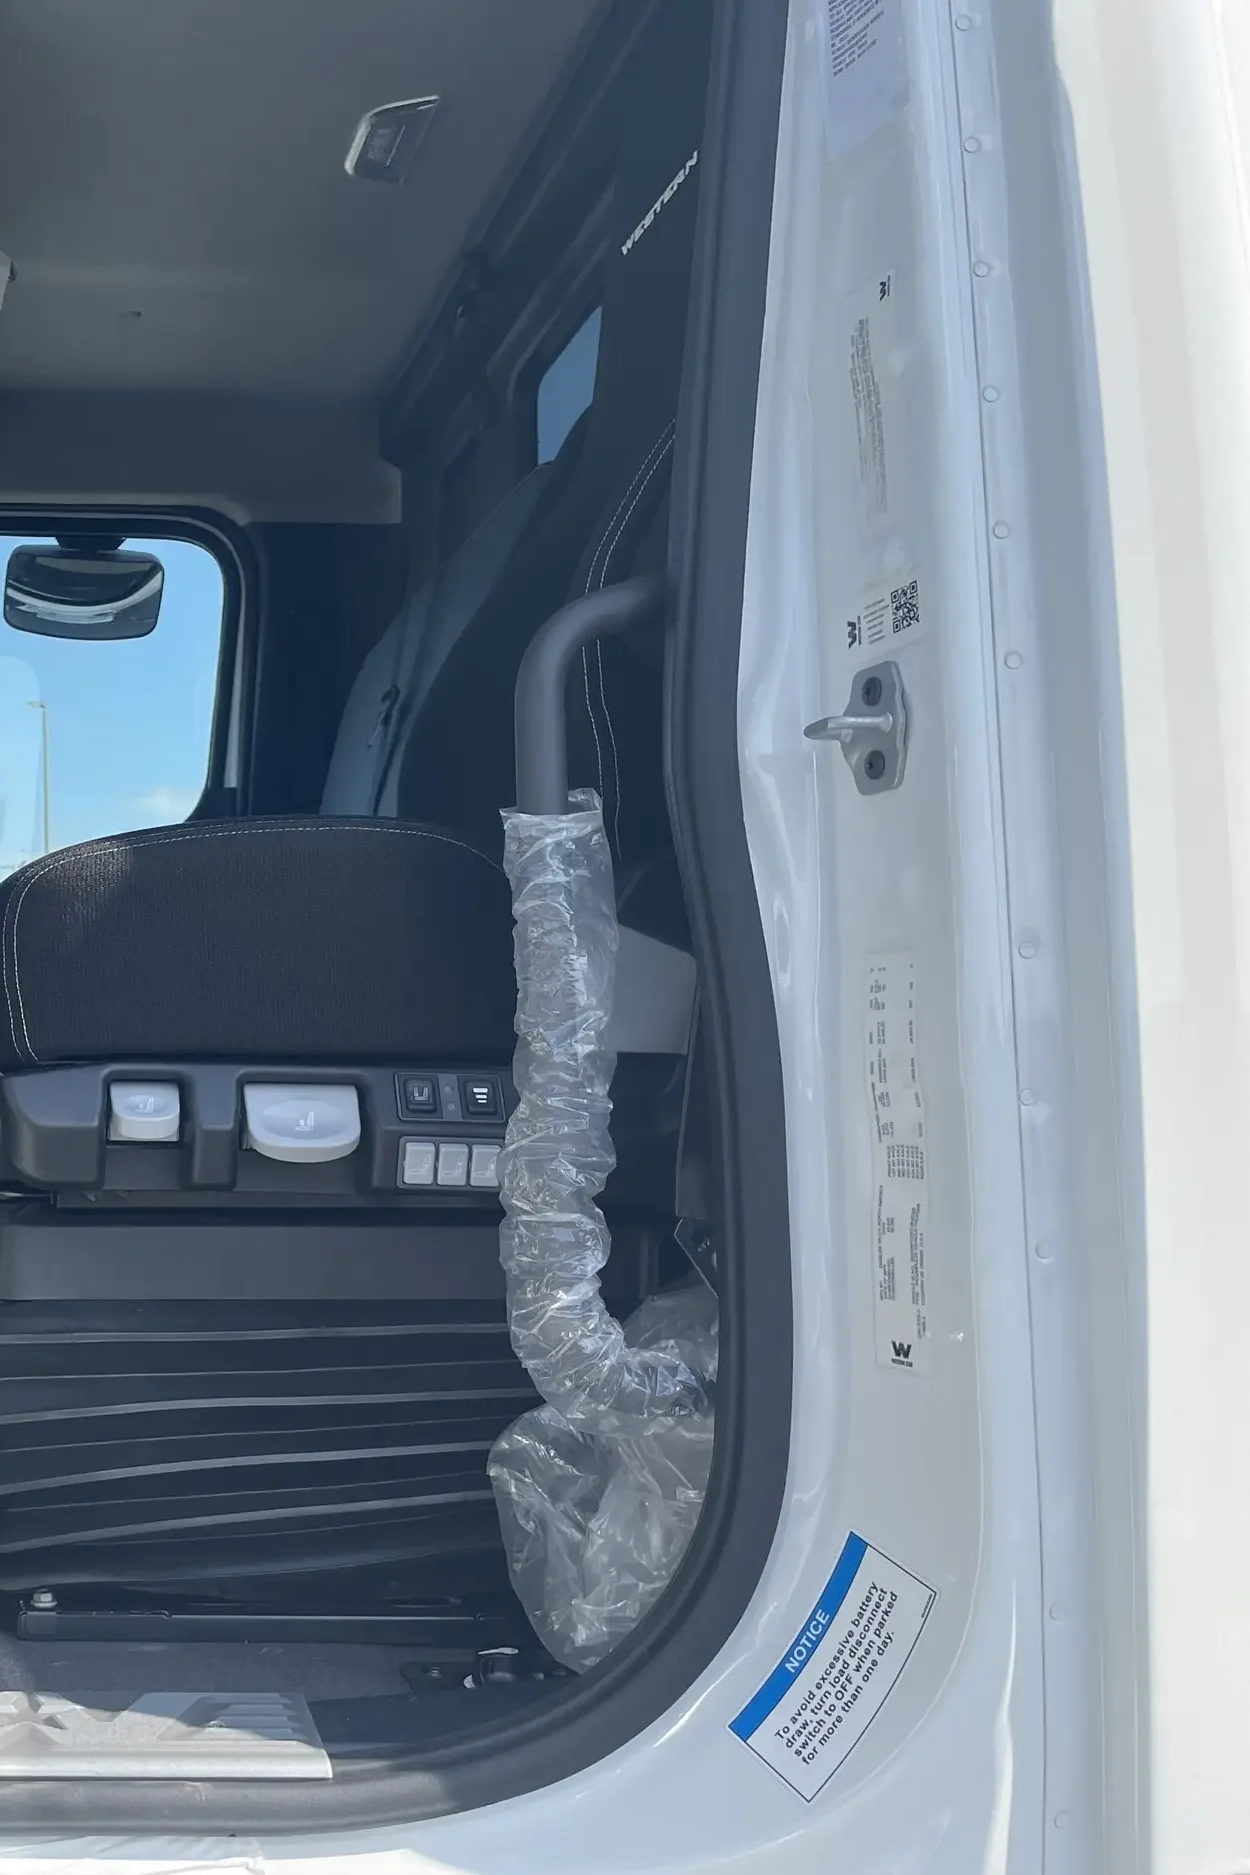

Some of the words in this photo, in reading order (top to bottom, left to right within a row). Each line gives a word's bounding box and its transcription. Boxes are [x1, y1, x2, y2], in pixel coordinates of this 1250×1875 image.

[621, 150, 698, 255] WESTERN
[774, 1726, 790, 1740] To
[790, 1690, 816, 1725] avoid
[815, 1629, 854, 1690] excessive
[851, 1582, 878, 1628] battery
[784, 1608, 830, 1674] NOTICE
[786, 1719, 813, 1749] draw,
[810, 1690, 832, 1715] turn
[828, 1659, 850, 1689] load
[849, 1587, 888, 1659] disconnect
[794, 1718, 826, 1757] switch
[824, 1704, 836, 1717] to
[834, 1673, 853, 1701] OFF
[853, 1640, 876, 1673] when
[873, 1591, 898, 1639] parked
[801, 1746, 819, 1765] for
[818, 1715, 843, 1746] more
[841, 1685, 863, 1713] than
[862, 1659, 878, 1683] one
[877, 1631, 895, 1656] day.
